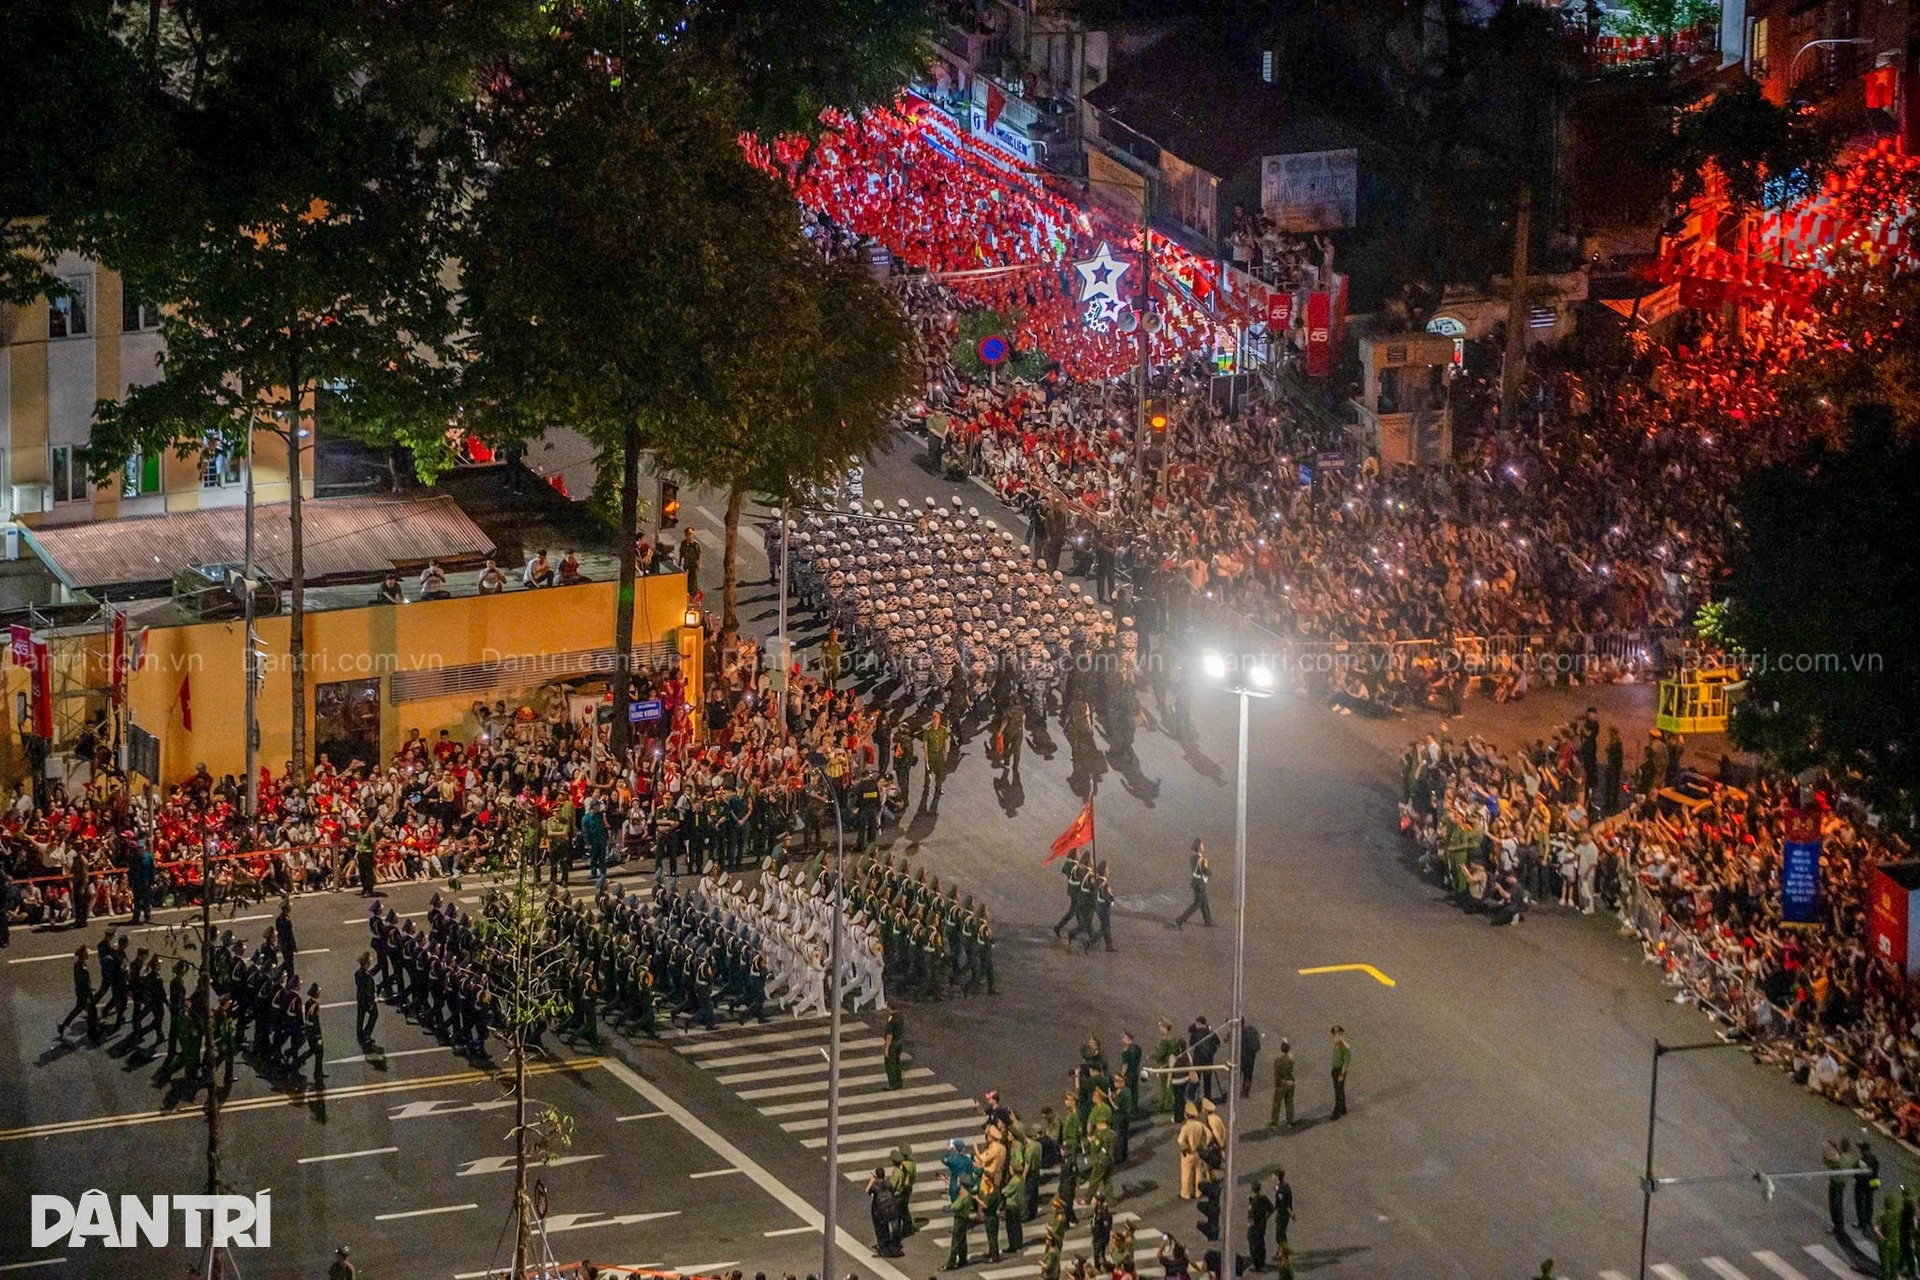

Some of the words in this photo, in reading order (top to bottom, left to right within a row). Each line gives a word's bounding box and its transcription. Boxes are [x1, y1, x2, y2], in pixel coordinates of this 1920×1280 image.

[1271, 308, 1288, 319] 5G
[1311, 331, 1328, 342] 5G
[13, 642, 29, 656] 5G
